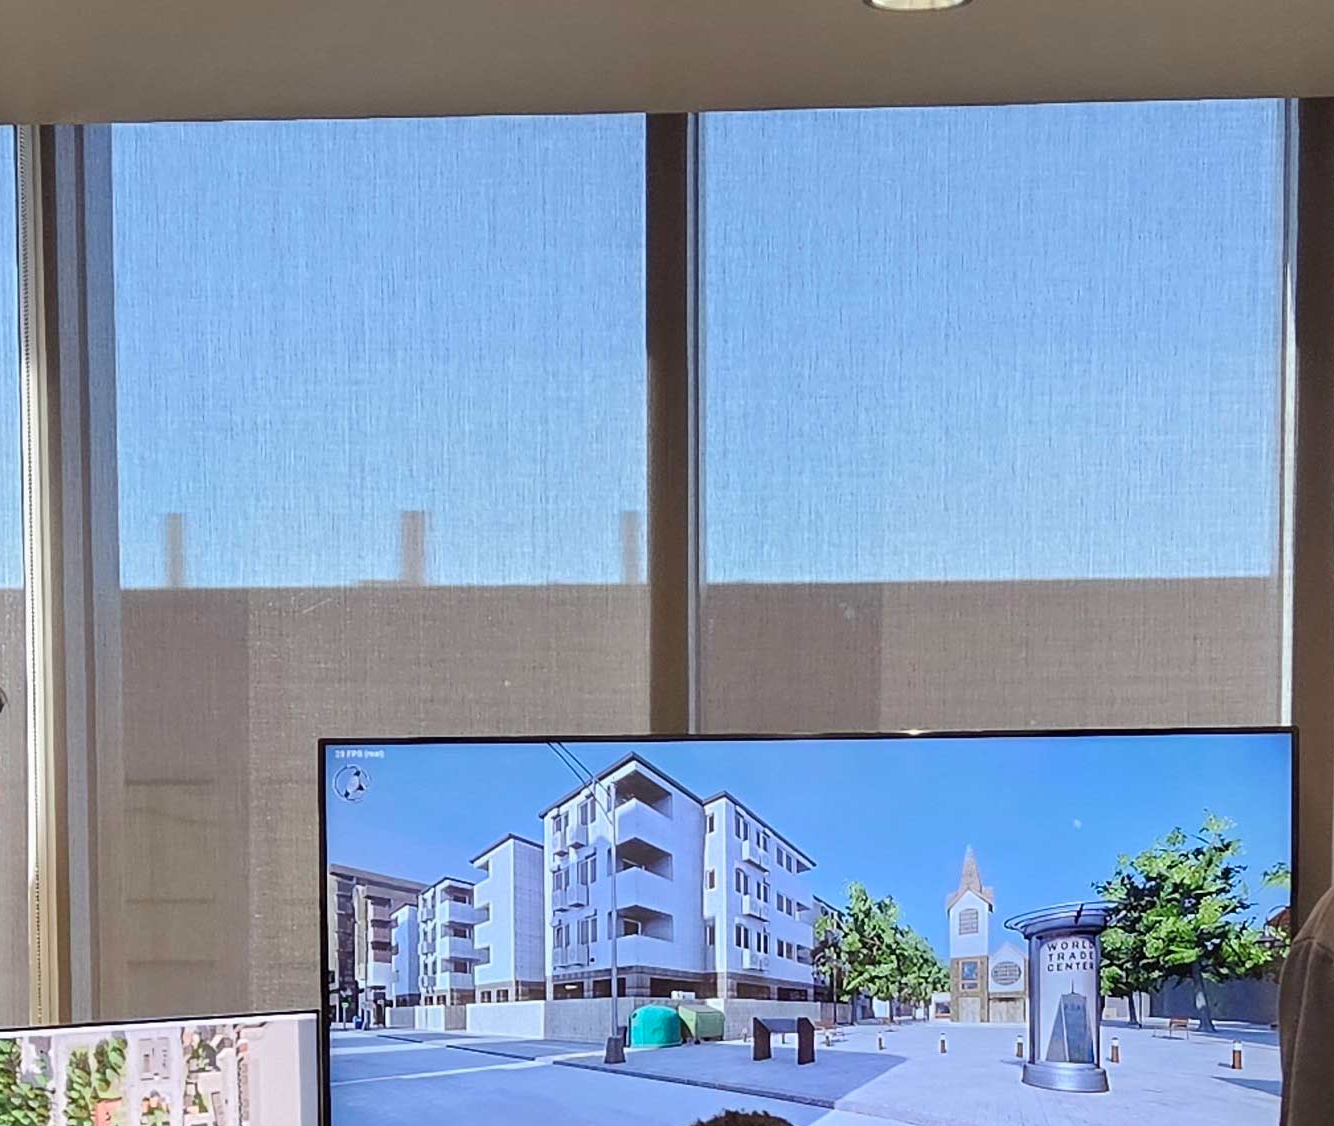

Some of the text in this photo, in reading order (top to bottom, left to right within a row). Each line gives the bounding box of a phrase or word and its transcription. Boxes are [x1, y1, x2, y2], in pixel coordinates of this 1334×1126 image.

[1047, 940, 1094, 952] WORLD
[1048, 951, 1094, 962] TRADE
[1047, 961, 1094, 972] CENTER
